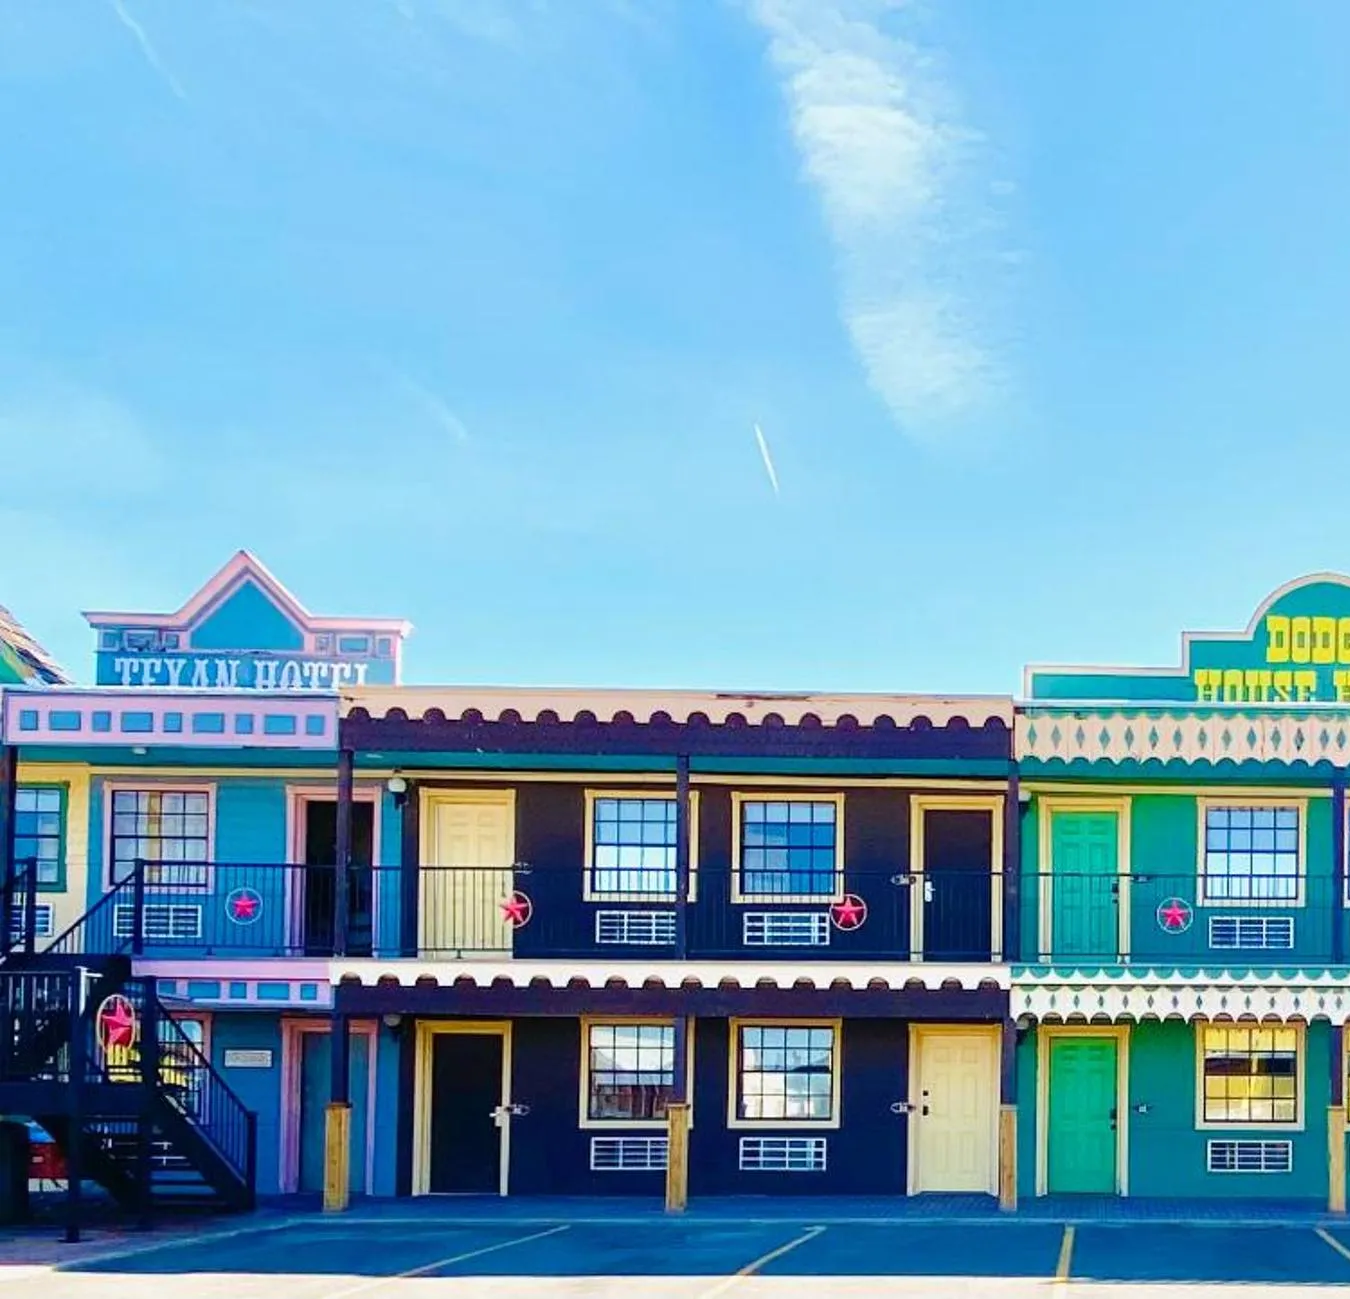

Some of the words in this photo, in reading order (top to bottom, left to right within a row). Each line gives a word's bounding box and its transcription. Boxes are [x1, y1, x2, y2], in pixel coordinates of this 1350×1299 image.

[114, 657, 241, 687] TEXAN
[253, 660, 368, 689] HOTEL
[1194, 669, 1317, 703] HOUSE
